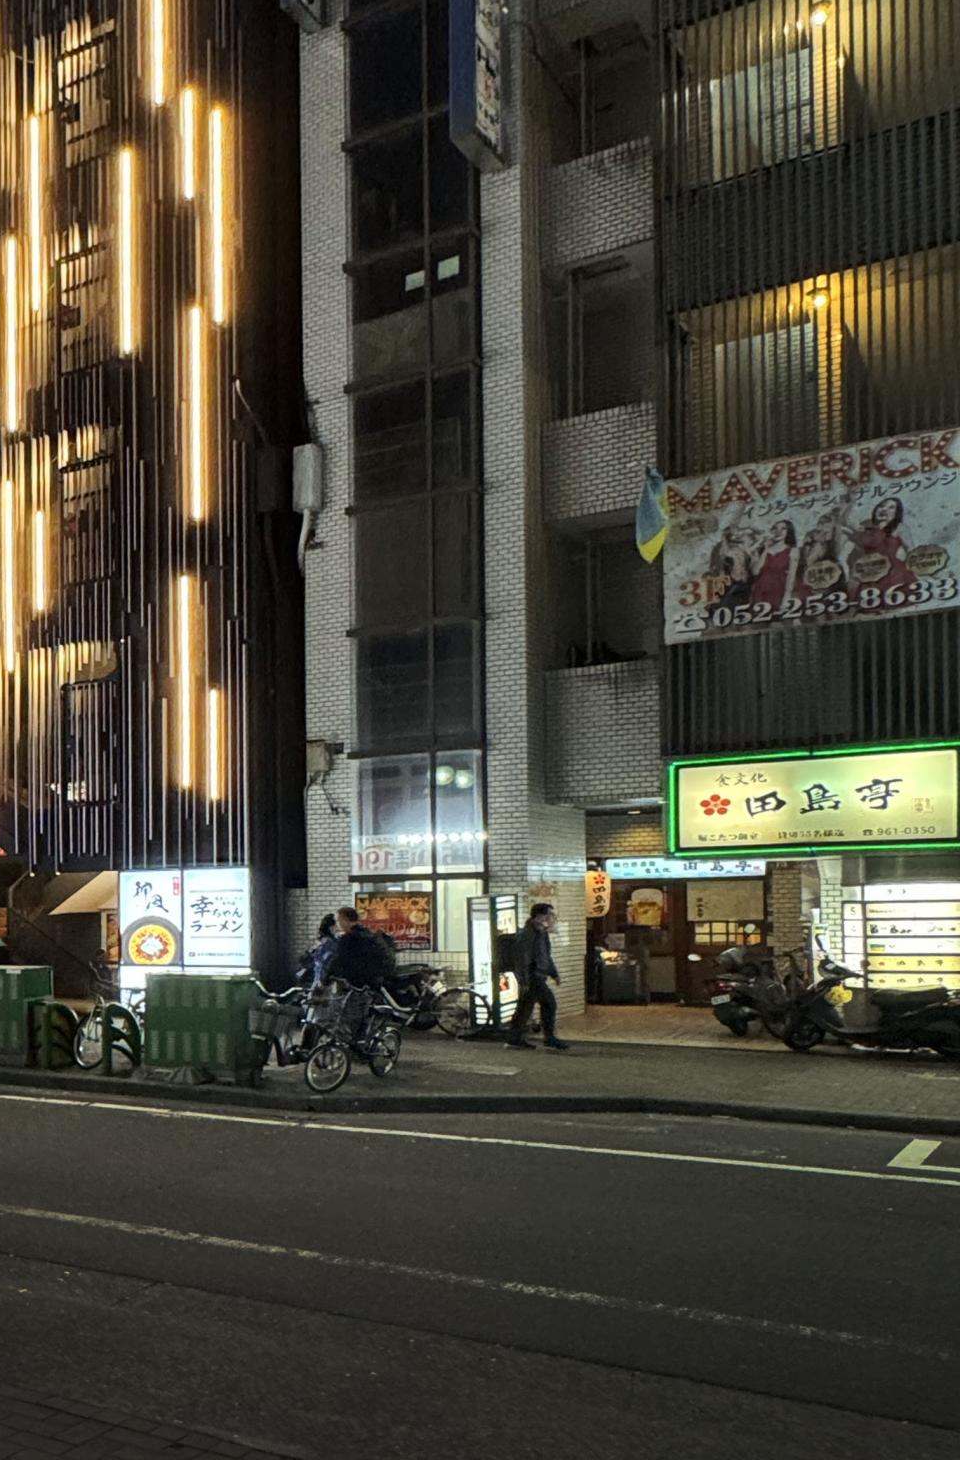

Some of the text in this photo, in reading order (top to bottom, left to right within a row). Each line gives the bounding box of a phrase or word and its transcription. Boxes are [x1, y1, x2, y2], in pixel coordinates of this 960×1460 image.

[664, 429, 960, 516] MAVERICK
[711, 575, 959, 628] 052-253-8633
[714, 771, 768, 787] 食文化
[744, 778, 904, 818] 田島亭
[876, 825, 936, 836] 961-0350
[189, 919, 244, 933] ラーメン
